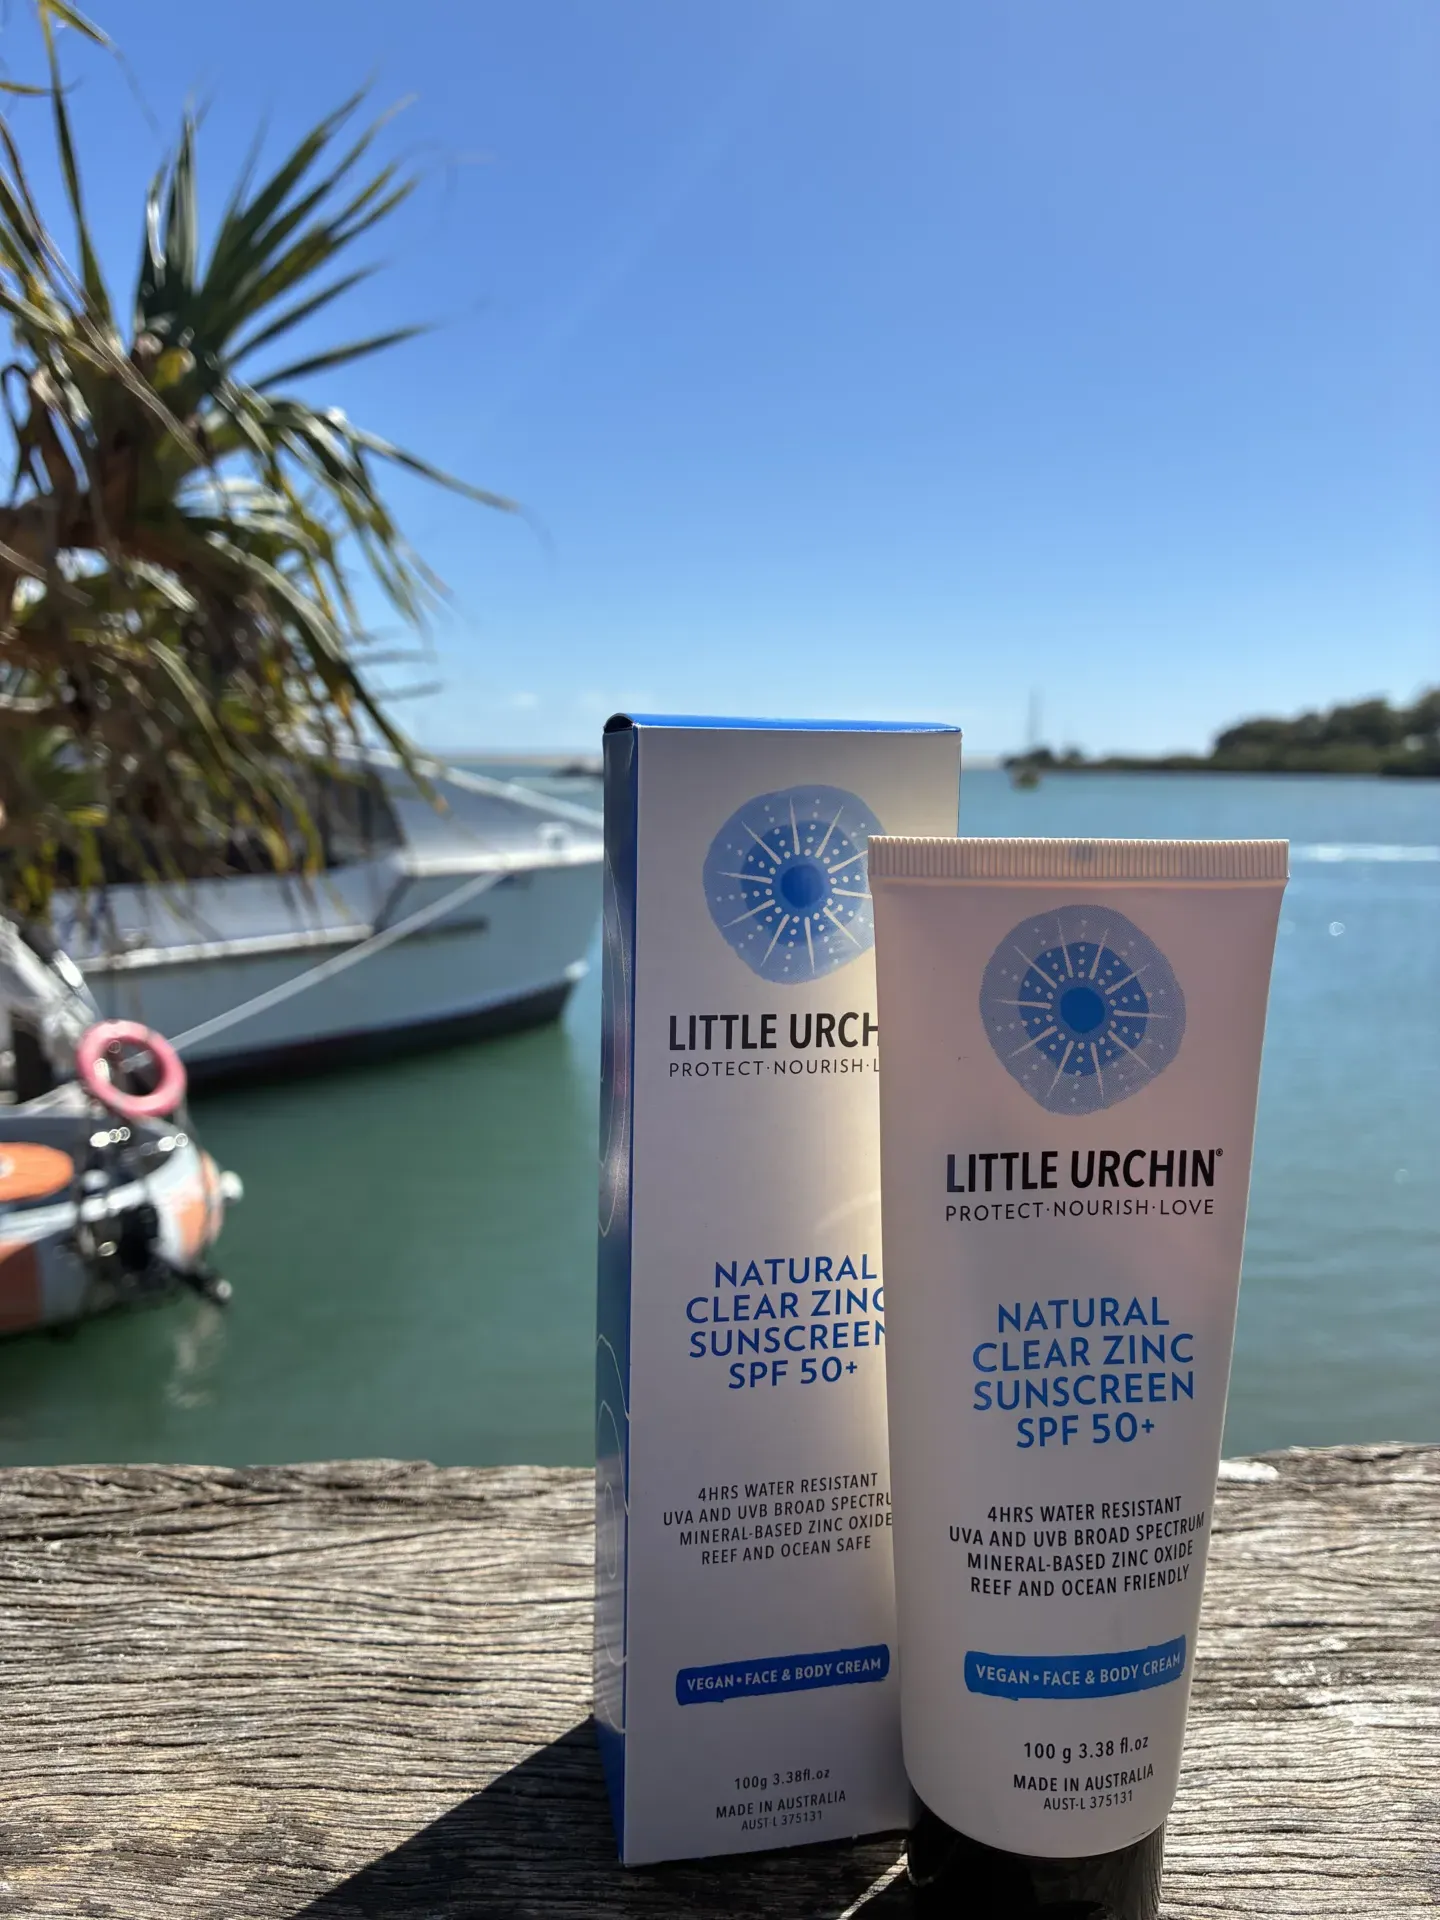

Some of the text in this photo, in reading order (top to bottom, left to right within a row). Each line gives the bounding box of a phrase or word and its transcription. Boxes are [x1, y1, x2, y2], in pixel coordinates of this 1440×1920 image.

[669, 1013, 777, 1051] LITTLE
[946, 1150, 1058, 1193] LITTLE
[714, 1254, 877, 1289] NATURAL
[685, 1292, 799, 1324] CLEAR
[998, 1296, 1170, 1333] NATURAL
[972, 1333, 1194, 1373] CLEAR ZINC
[728, 1356, 858, 1390] SPF 50+
[973, 1371, 1194, 1411] SUNSCREEN
[1016, 1411, 1155, 1449] SPF 50+
[697, 1472, 878, 1502] 4HRS WATER RESISTANT
[663, 1509, 694, 1526] UVA
[698, 1507, 731, 1523] AND
[738, 1503, 768, 1520] UVB
[774, 1498, 825, 1517] BROAD
[987, 1495, 1182, 1523] 4HRS WATER RESISTANT
[679, 1512, 893, 1546] MINERAL-BASED ZINC OXIDE
[949, 1511, 1205, 1548] UVA AND UVB BROAD SPECTRUM
[701, 1535, 871, 1565] REEF AND OCEAN SAFE
[967, 1539, 1193, 1572] MINERAL-BASED ZINC OXIDE
[971, 1563, 1190, 1597] REEF AND OCEAN FRIENDLY
[687, 1658, 881, 1691] VEGAN FACE & BODY CREAM
[975, 1652, 1181, 1686] VEGAN FACE & BODY CREAM
[1078, 1740, 1114, 1759] 3.38
[734, 1775, 767, 1791] 100g
[1013, 1763, 1154, 1792] MADE IN AUSTRALIA
[716, 1789, 846, 1819] MADE IN AUSTRALIA
[1089, 1789, 1133, 1809] 375131
[781, 1810, 822, 1826] 375131
